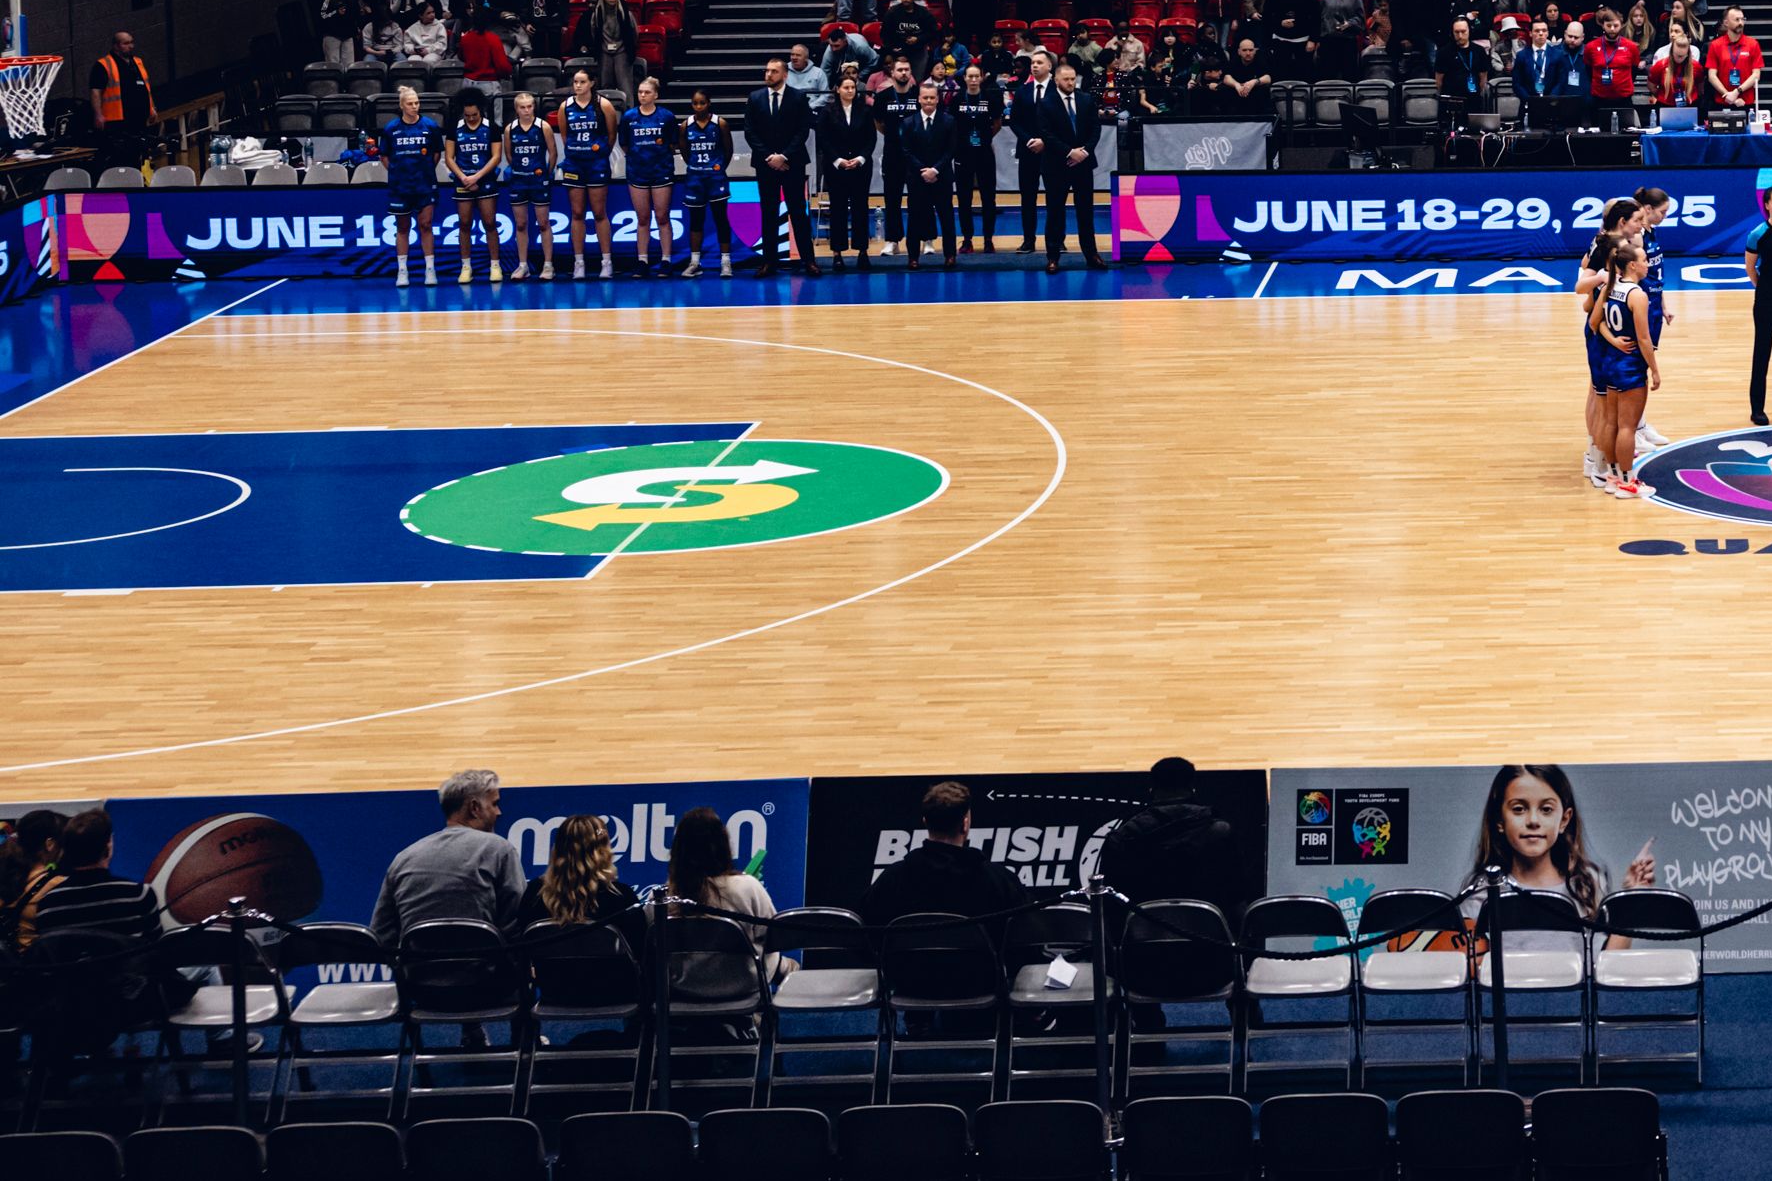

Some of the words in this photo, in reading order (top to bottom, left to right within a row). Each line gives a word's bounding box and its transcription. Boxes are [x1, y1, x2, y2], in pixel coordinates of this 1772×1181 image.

[569, 121, 598, 131] EESTI
[576, 132, 591, 142] 18
[634, 128, 662, 137] EESTI
[396, 136, 427, 146] EESTI
[459, 143, 488, 153] EESTI
[471, 154, 480, 164] 5
[521, 157, 530, 167] 9
[697, 154, 710, 163] 13
[1233, 199, 1386, 233] JUNE
[1397, 197, 1562, 233] 18-29,
[186, 216, 345, 250] JUNE
[355, 212, 513, 247] 18-29
[1603, 302, 1623, 332] 10
[507, 803, 767, 866] moltn
[1301, 832, 1327, 846] FIBA
[1700, 823, 1733, 851] TO
[1739, 817, 1771, 852] MY
[874, 826, 1079, 865] BTISH
[1694, 899, 1712, 910] OIN
[1715, 899, 1729, 910] US
[1731, 899, 1754, 910] AND
